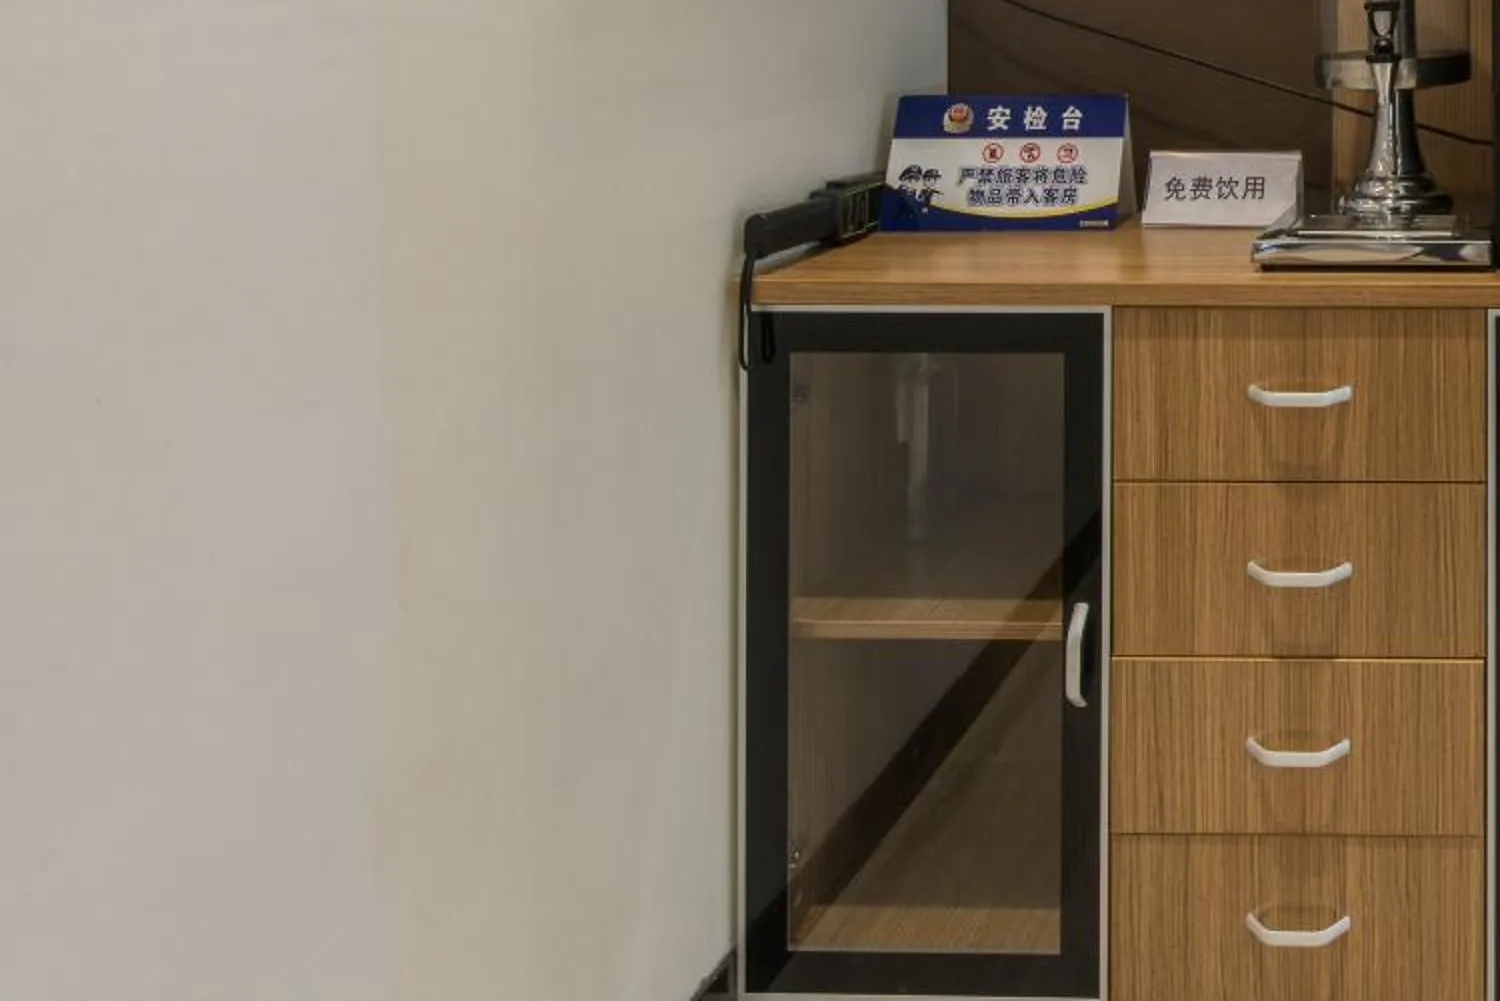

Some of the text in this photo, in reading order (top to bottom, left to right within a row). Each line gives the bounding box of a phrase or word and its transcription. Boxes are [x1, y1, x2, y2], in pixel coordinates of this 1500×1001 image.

[986, 105, 1084, 131] 安检台
[957, 166, 1088, 186] 严禁旅客将危险
[967, 187, 1079, 208] 物品带入客房
[1164, 176, 1266, 201] 免费饮用
